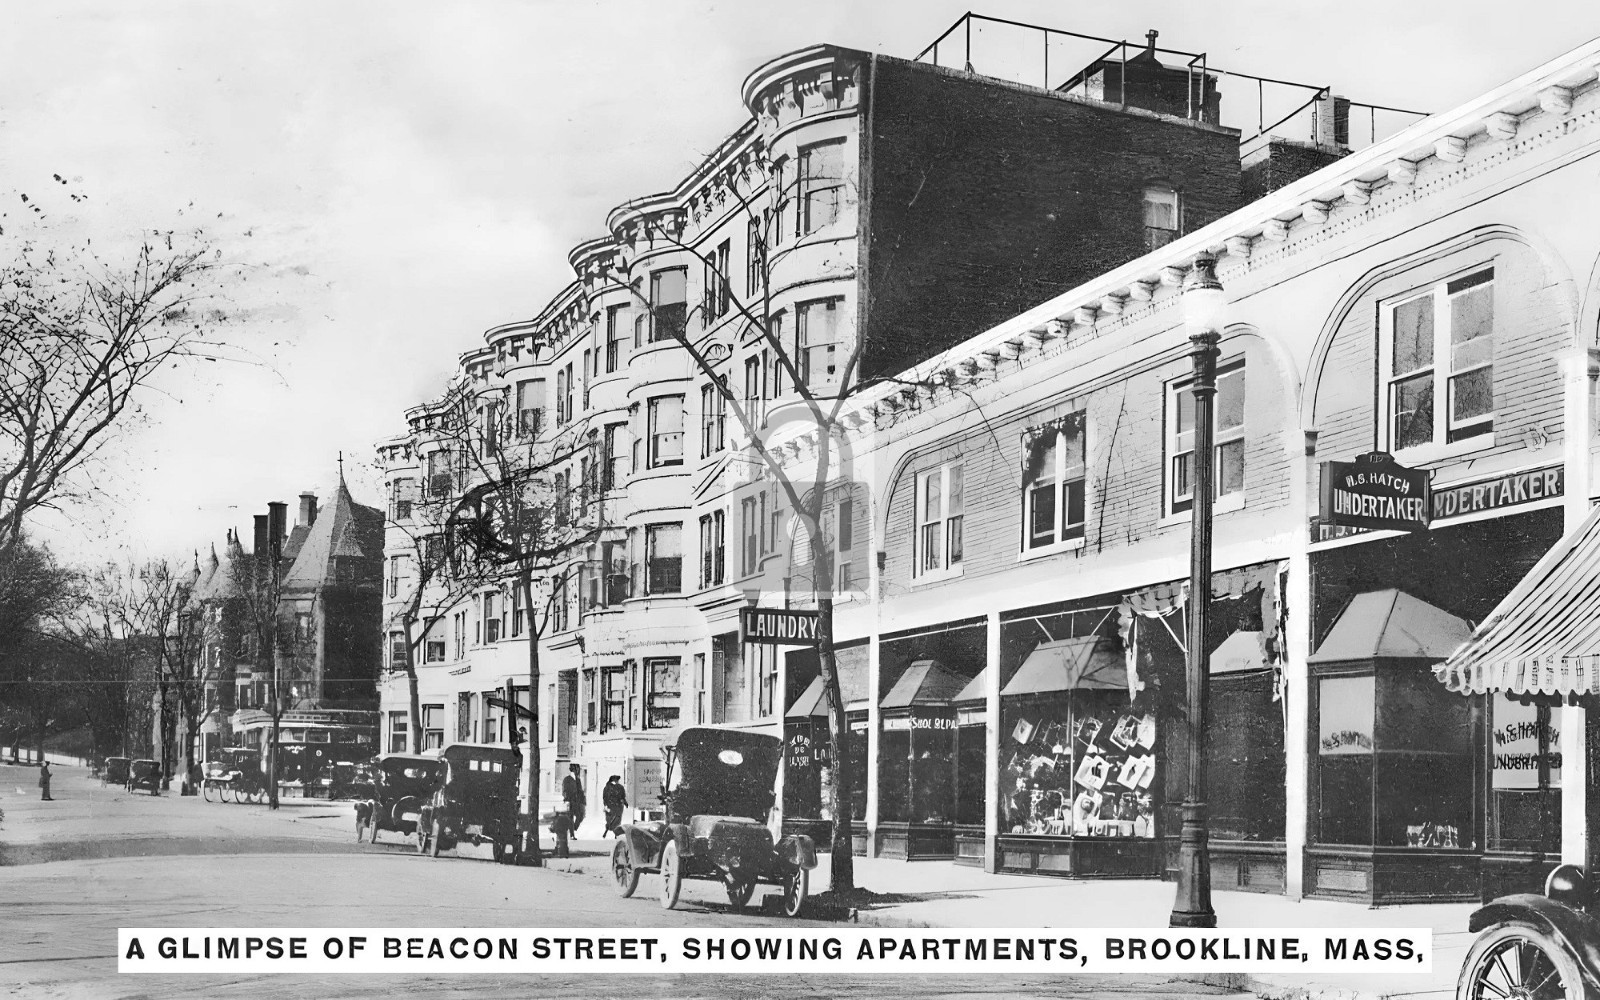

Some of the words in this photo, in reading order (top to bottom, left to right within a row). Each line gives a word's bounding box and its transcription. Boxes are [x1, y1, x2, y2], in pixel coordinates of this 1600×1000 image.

[1370, 472, 1410, 495] HATCH
[1434, 469, 1559, 517] NDERTAKER
[1333, 487, 1424, 521] UNDERTAKER
[747, 613, 818, 639] LAUNDRY
